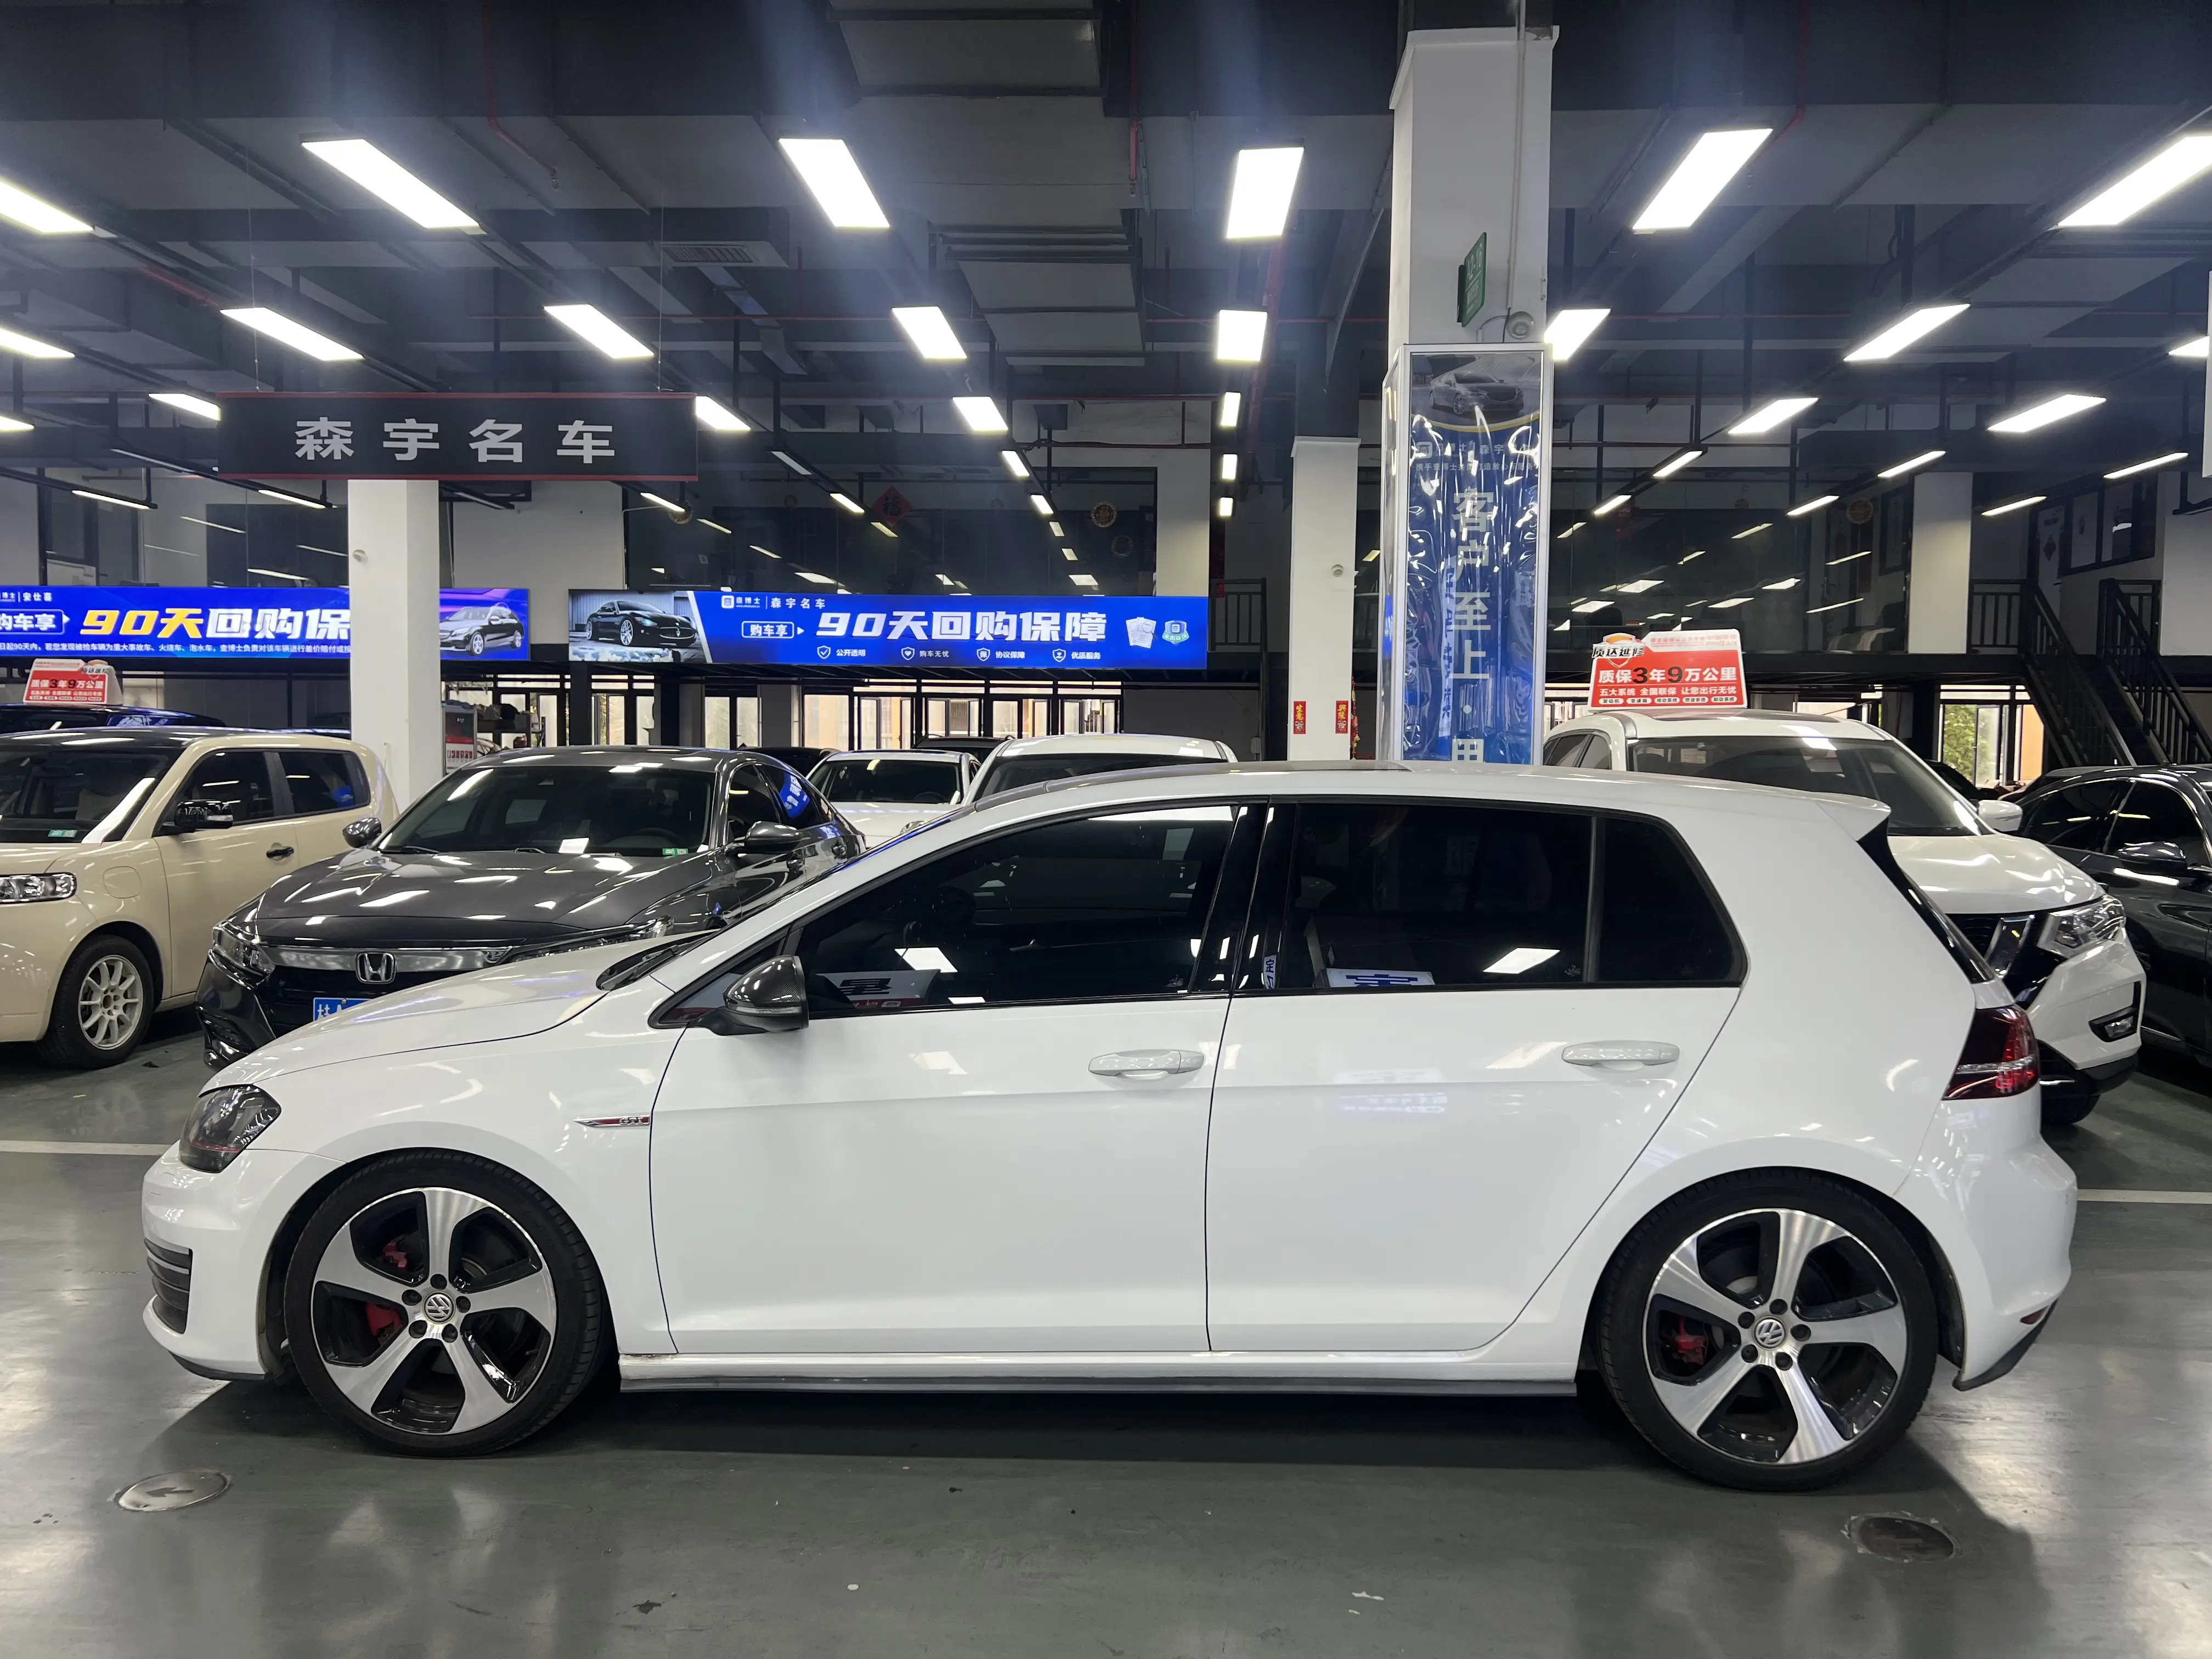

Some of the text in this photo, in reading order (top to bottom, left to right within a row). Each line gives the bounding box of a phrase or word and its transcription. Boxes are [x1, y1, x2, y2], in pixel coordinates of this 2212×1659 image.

[295, 417, 616, 464] 森宇名车
[771, 597, 825, 609] 森宇名车
[750, 624, 788, 637] 购车享
[816, 611, 1107, 642] 90天回购保障
[836, 649, 866, 657] 公开透明
[919, 650, 950, 658] 购车无忧
[995, 651, 1025, 659] 协议保障
[1071, 651, 1101, 660] 优质服务
[1598, 666, 1737, 684] 质保3年9万公里
[1600, 686, 1737, 696] 五大系统 全国联保 让您出行无忧
[619, 1117, 644, 1125] GTI
